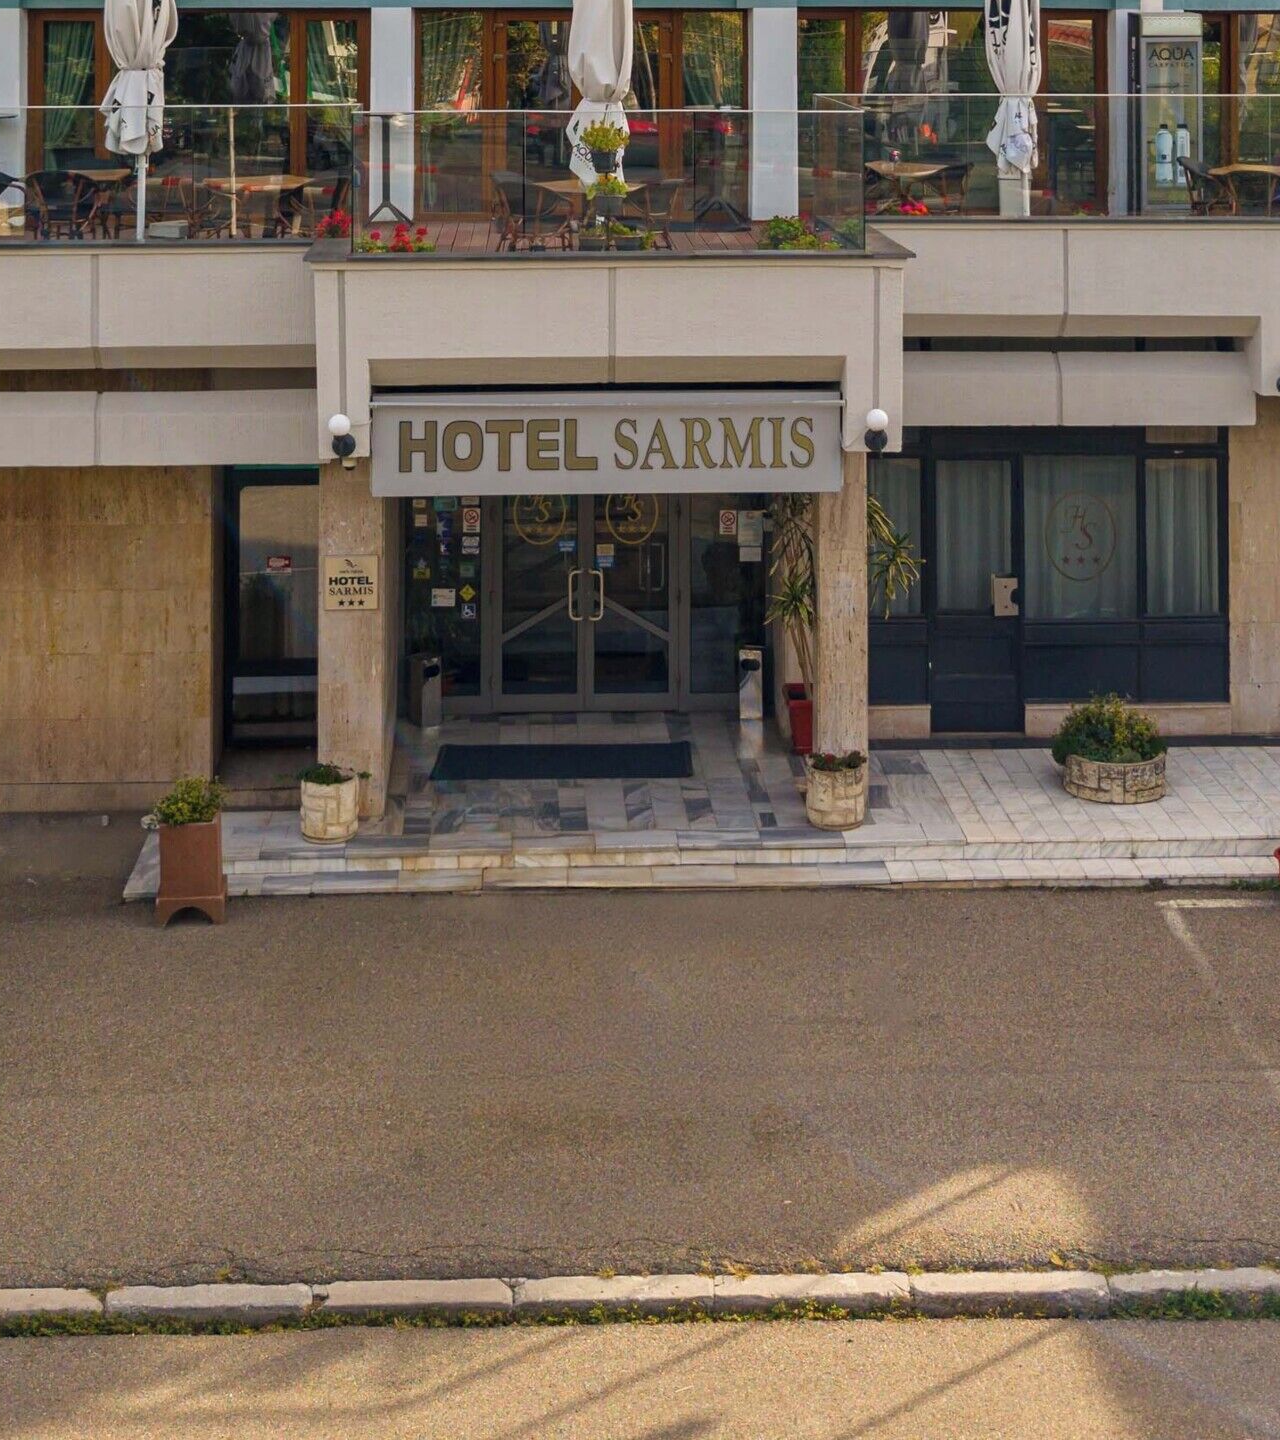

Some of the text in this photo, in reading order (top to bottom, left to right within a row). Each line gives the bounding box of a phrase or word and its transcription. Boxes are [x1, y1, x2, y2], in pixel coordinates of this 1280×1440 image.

[1148, 47, 1194, 61] AQUA
[399, 417, 815, 472] HOTEL SARMIS
[328, 576, 374, 586] HOTEL
[328, 586, 374, 596] SARMIS
